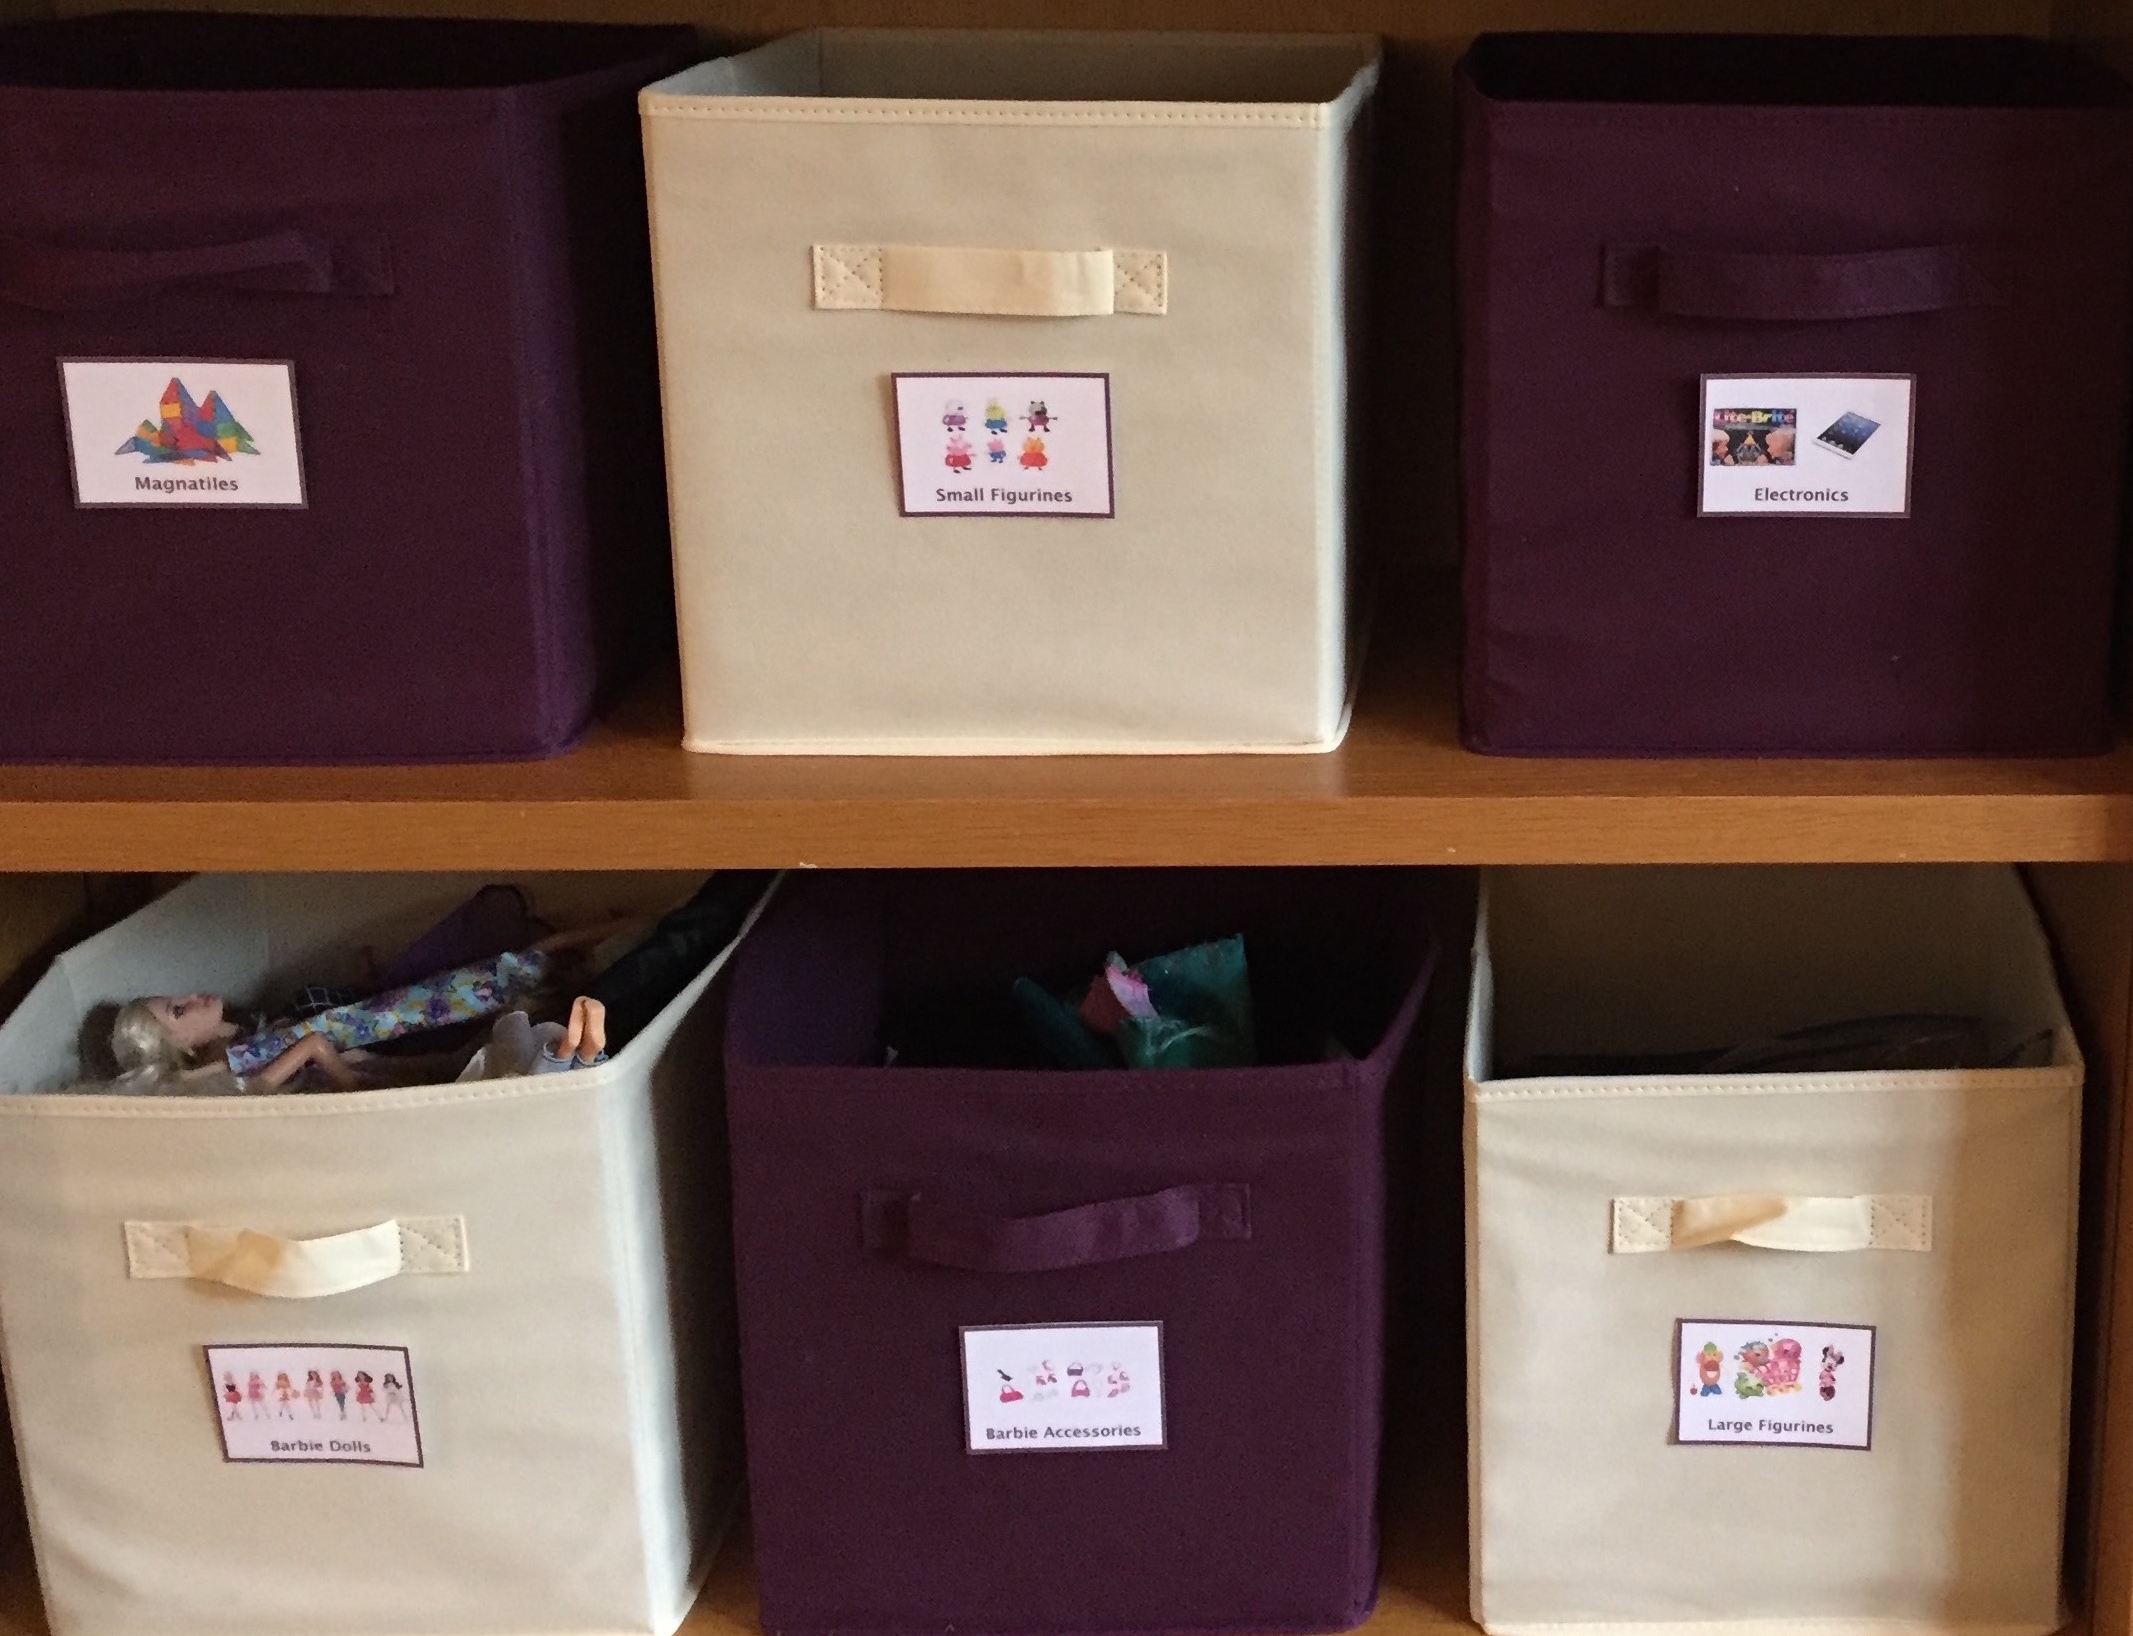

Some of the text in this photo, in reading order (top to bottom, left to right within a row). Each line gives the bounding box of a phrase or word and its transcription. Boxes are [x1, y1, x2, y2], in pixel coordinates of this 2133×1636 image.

[134, 476, 239, 495] Magnatiles
[935, 487, 1073, 505] Small Figurines
[1754, 487, 1849, 502] Electronics
[985, 1425, 1142, 1440] Barbie Accessories
[1708, 1418, 1834, 1435] Large Figurines
[271, 1439, 371, 1454] Barbie Dolls
